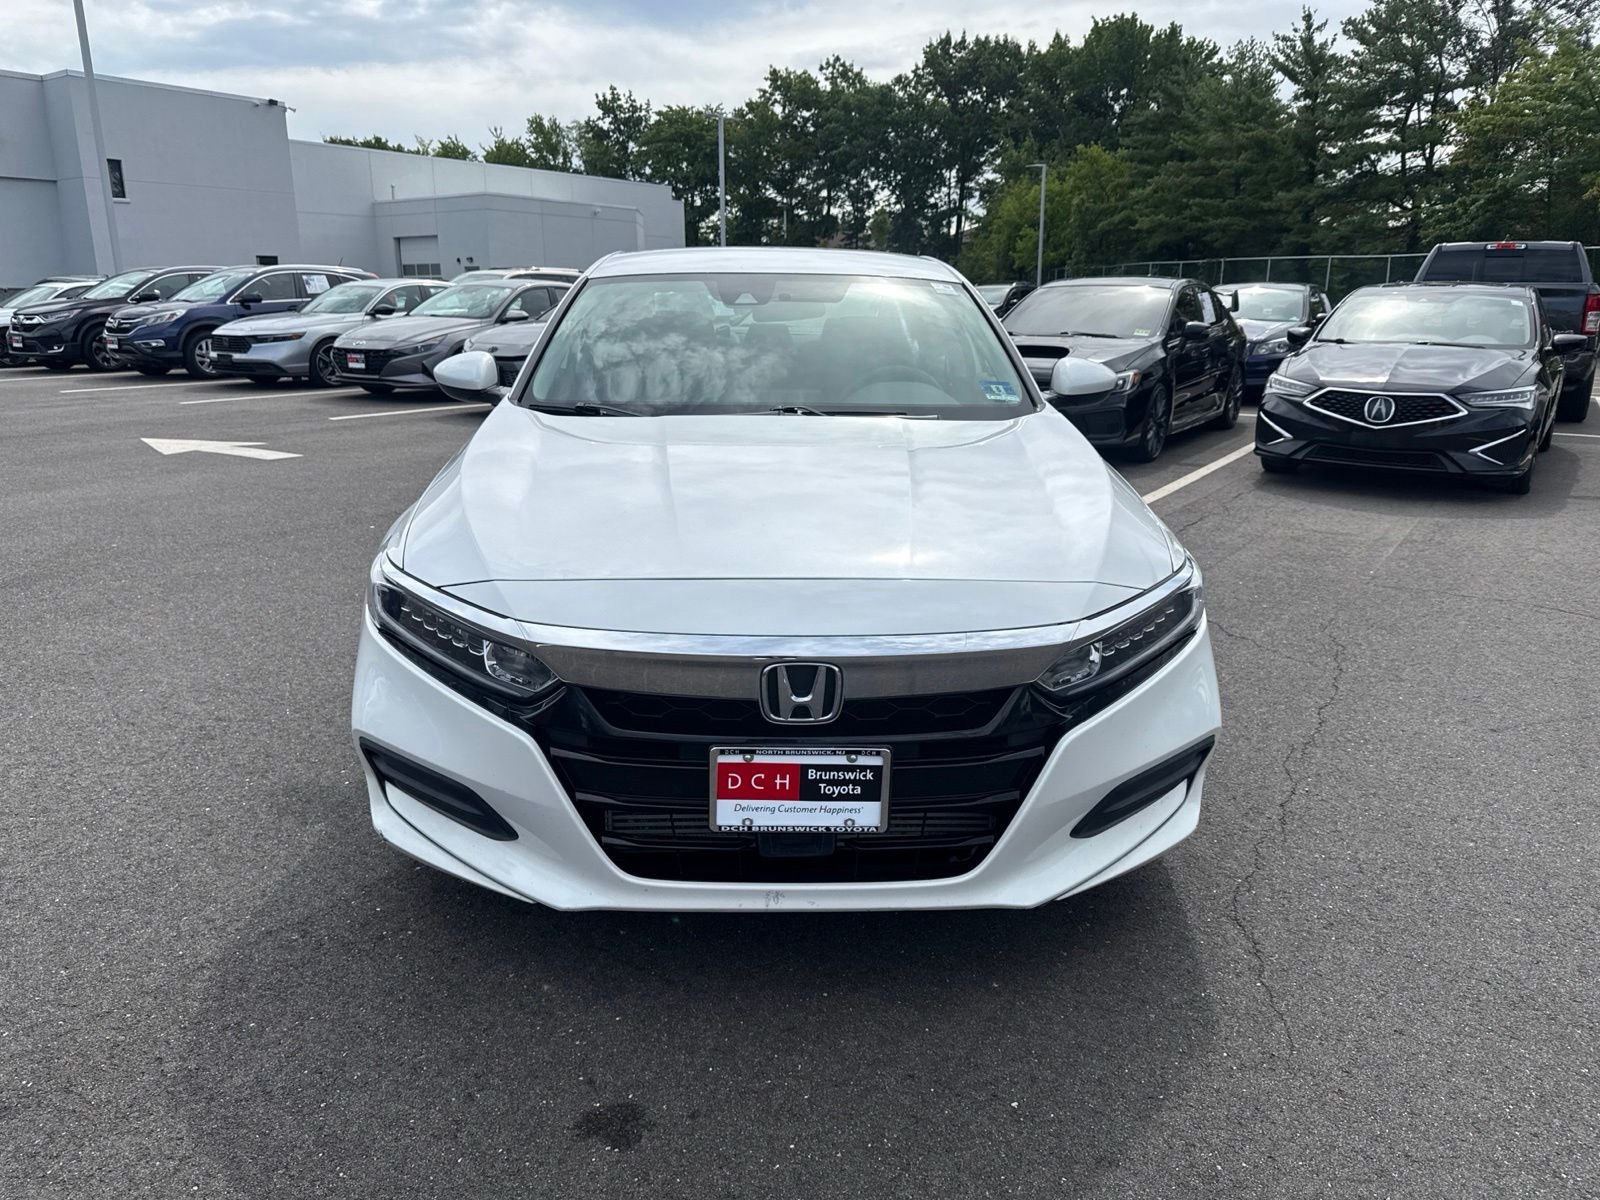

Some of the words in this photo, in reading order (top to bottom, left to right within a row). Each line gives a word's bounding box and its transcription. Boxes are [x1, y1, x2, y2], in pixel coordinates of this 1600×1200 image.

[808, 769, 874, 780] Brunswick
[728, 773, 790, 790] DCH
[819, 784, 861, 797] Toyota
[734, 803, 776, 814] Delivering
[777, 804, 818, 813] Customer
